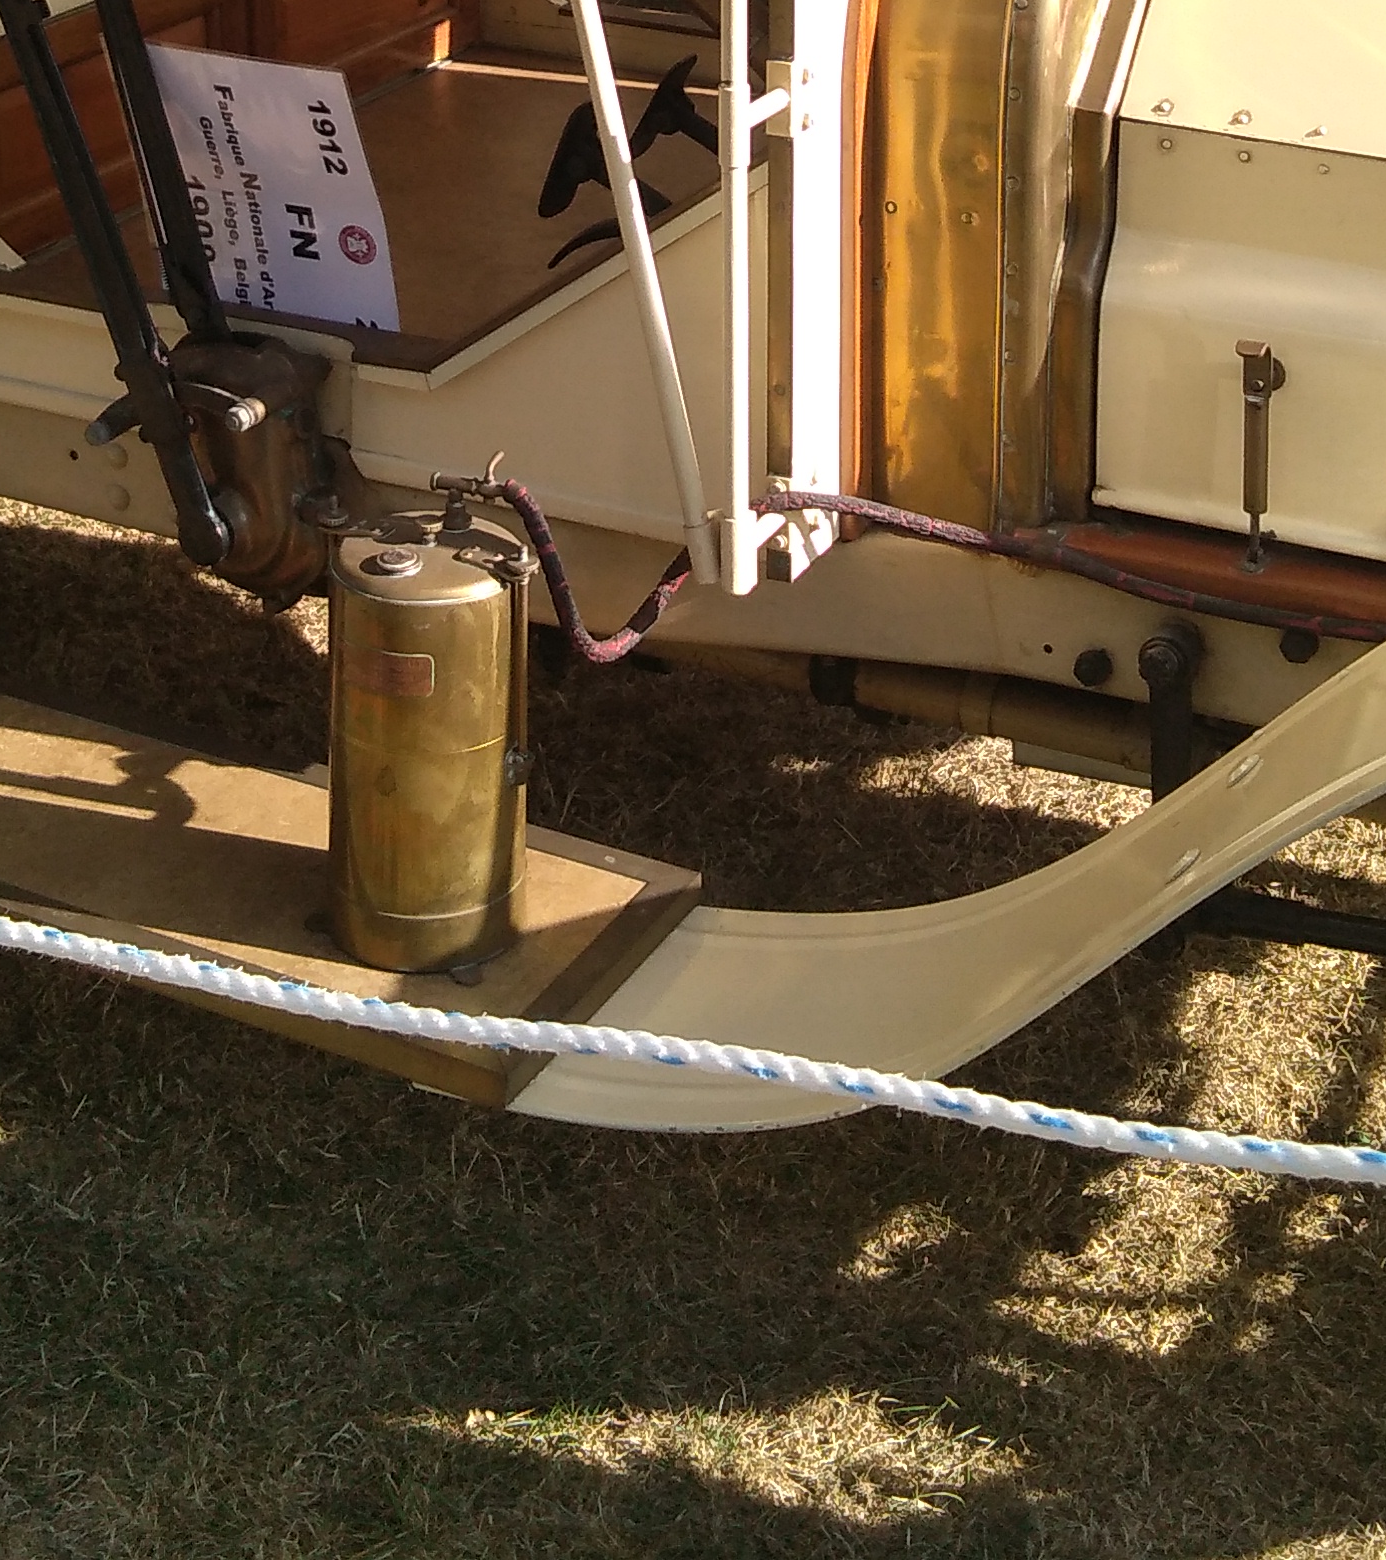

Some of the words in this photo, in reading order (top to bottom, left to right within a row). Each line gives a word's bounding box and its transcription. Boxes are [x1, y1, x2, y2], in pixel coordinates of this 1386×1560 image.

[199, 115, 225, 180] Guerre,
[221, 190, 240, 246] Liège,
[213, 83, 246, 167] Fabrique
[240, 171, 269, 265] Nationale
[307, 99, 349, 176] 1912
[284, 202, 321, 261] FN
